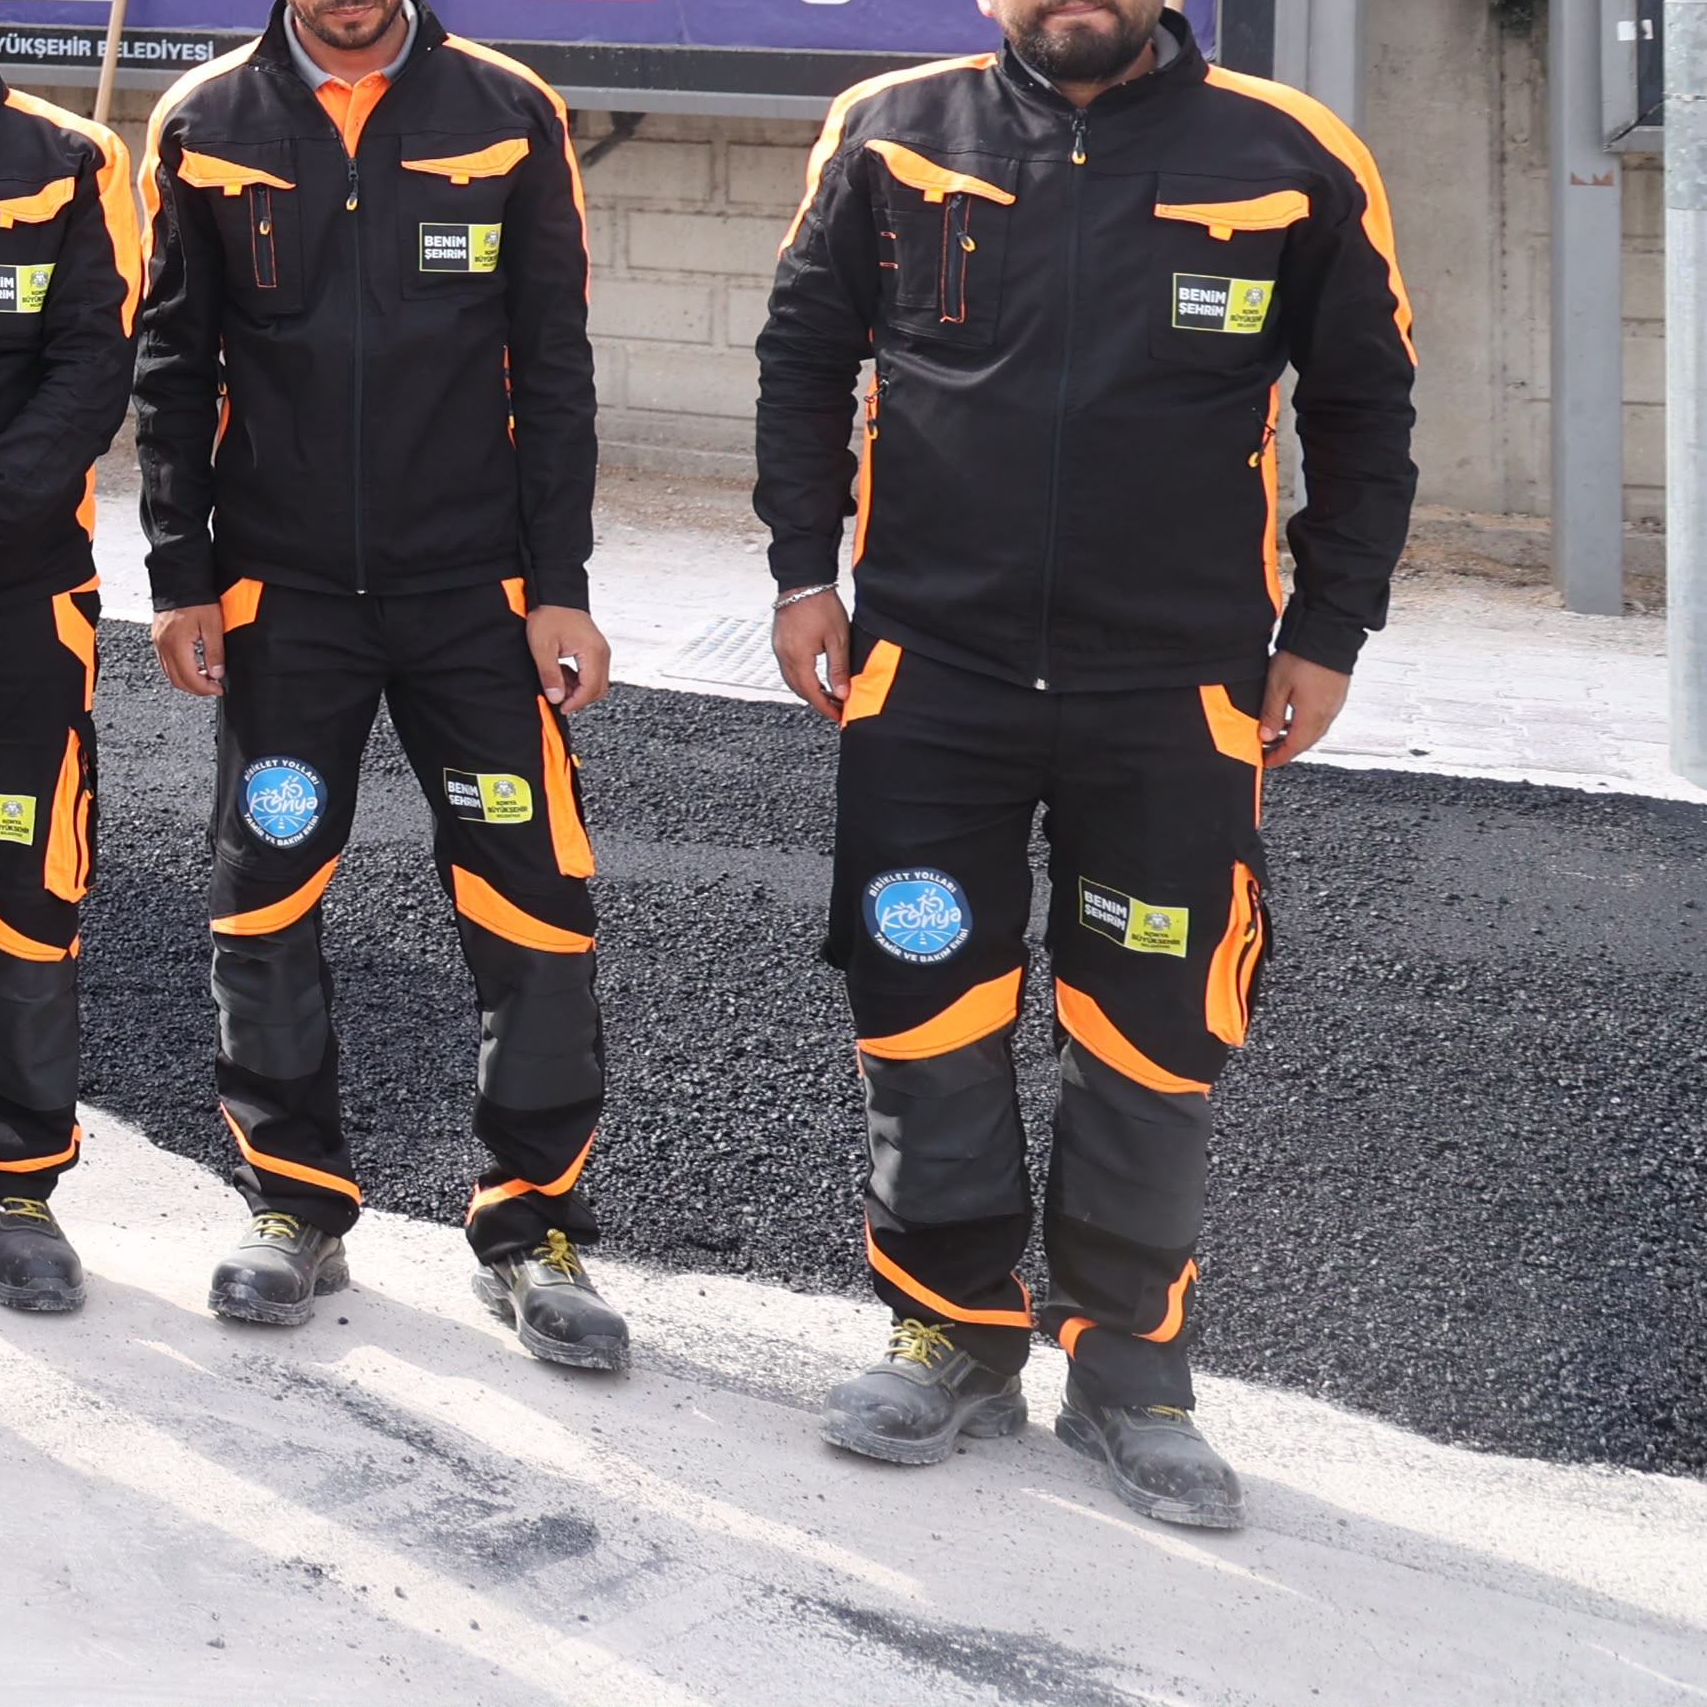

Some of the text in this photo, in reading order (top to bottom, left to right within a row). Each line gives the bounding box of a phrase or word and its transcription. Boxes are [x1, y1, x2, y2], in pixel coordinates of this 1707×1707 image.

[424, 236, 466, 248] BENİM
[425, 248, 467, 261] ŞEHRİM
[1179, 287, 1226, 304] BENİM
[1179, 302, 1224, 317] ŞEHRİM
[244, 759, 320, 786] BİSİKLET YOLLARI
[448, 781, 479, 797] BENİM
[449, 794, 482, 809] ŞEHRİM
[244, 812, 319, 846] TAMİR VE BAKIM EKİBİ
[868, 872, 957, 897] BİSİKLET YOLLARI
[1084, 891, 1127, 919] BENİM
[1084, 903, 1126, 931] ŞEHRİM
[874, 928, 969, 963] TAMİR VE BAKIM EKİBİ
